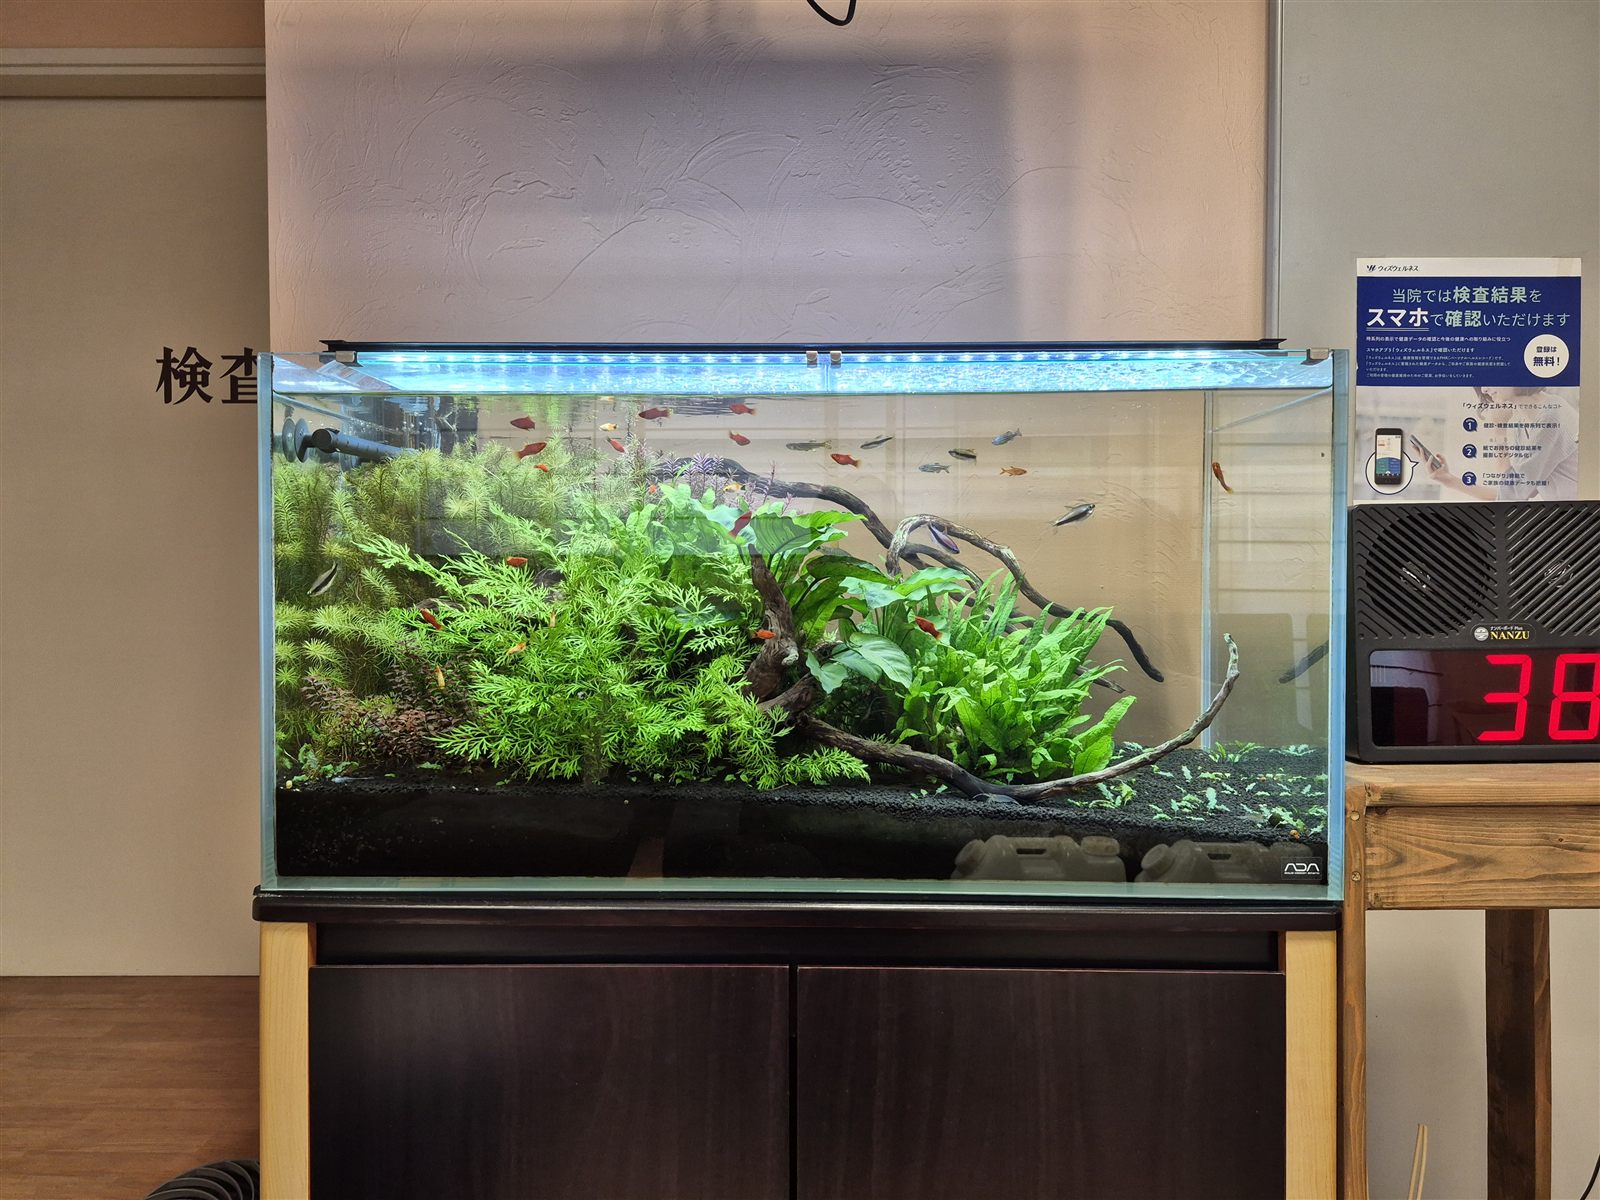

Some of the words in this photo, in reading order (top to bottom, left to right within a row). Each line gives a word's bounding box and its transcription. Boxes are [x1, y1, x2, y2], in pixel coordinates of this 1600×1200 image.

[1392, 286, 1542, 304] 当院では検査結果を
[1366, 308, 1571, 328] スマホで確認いただけます
[156, 346, 258, 405] 検査
[1490, 631, 1530, 640] NANZU
[1477, 653, 1600, 741] 38
[1284, 862, 1320, 872] ADA
